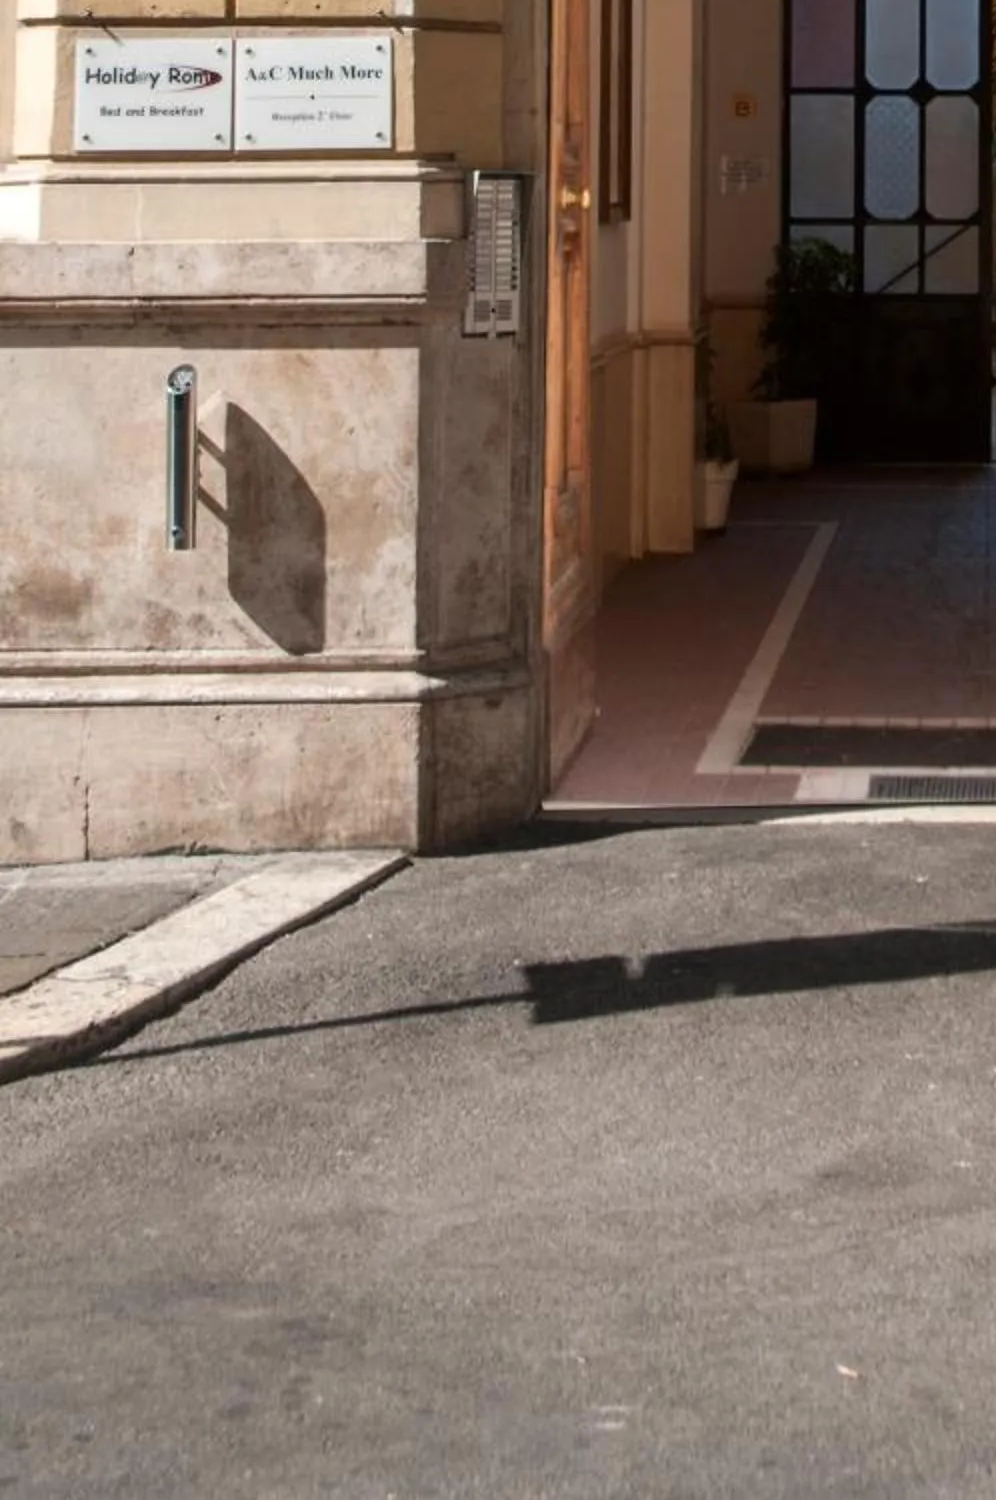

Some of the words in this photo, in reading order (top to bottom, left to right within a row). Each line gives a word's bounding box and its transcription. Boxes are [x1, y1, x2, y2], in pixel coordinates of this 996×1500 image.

[85, 67, 161, 90] Holiday
[287, 65, 334, 81] Much
[340, 65, 384, 80] More
[99, 106, 122, 117] Bed
[125, 107, 146, 117] and
[149, 106, 205, 117] Breakfast
